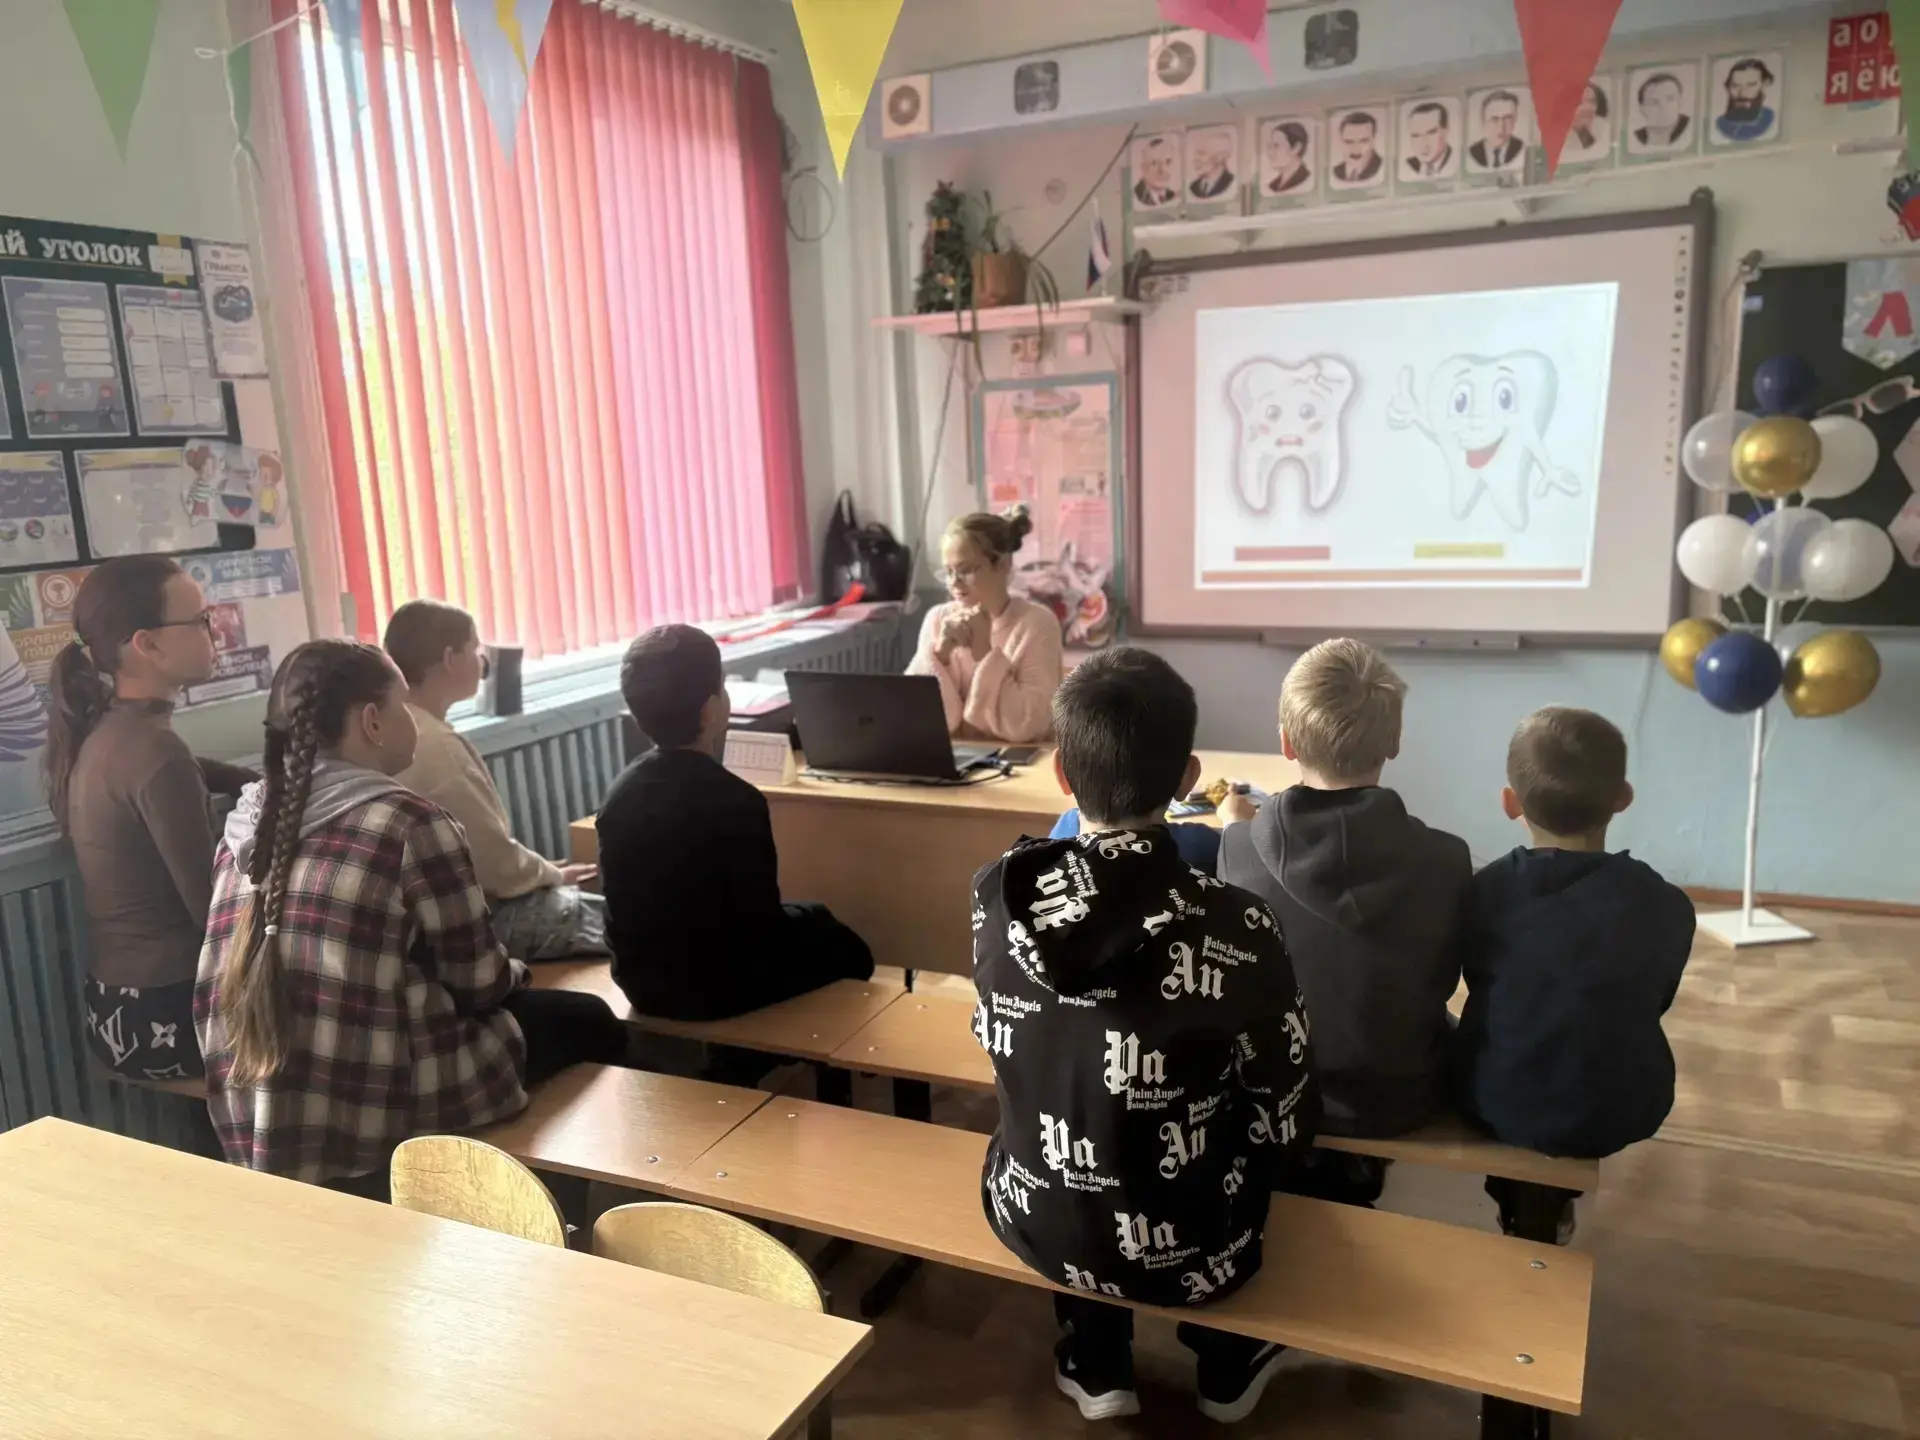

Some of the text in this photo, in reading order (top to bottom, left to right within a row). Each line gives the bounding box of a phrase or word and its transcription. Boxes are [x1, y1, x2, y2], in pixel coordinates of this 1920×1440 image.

[38, 237, 143, 266] УГОЛОК
[1160, 941, 1225, 1000] An
[1104, 1028, 1167, 1094] Pa
[1040, 1111, 1098, 1170] Pa
[1159, 1120, 1206, 1180] An
[1114, 1210, 1180, 1260] Pa
